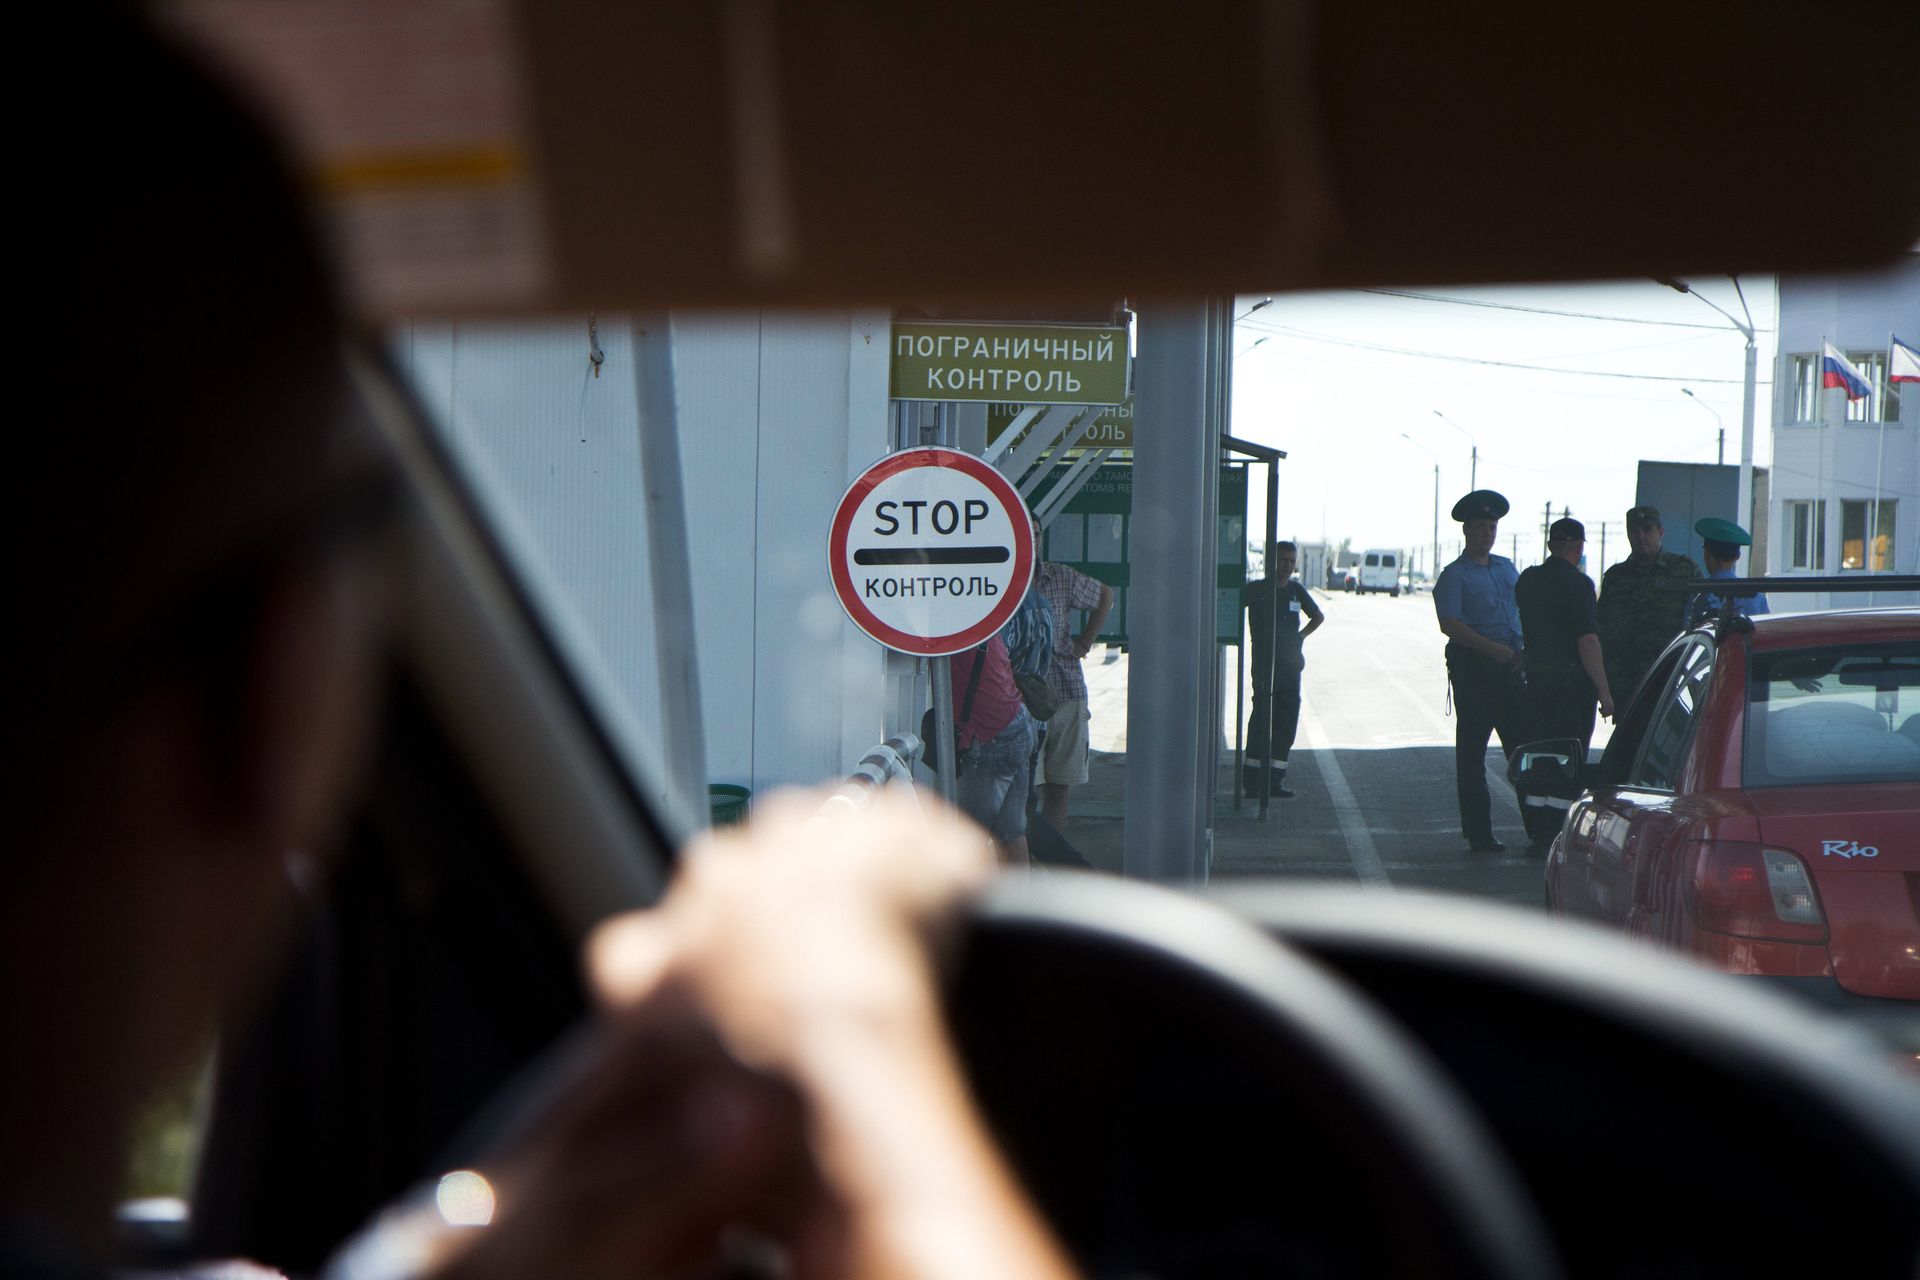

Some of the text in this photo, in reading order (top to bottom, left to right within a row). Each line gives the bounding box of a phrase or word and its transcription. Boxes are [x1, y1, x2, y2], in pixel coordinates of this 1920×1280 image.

[897, 334, 1113, 362] ПОГРАНИЧНЫЙ
[927, 367, 1081, 392] КОНТРОЛЬ
[873, 499, 989, 536] STOP
[865, 576, 998, 598] КОНТРОЛЬ
[1821, 840, 1879, 859] Rio
